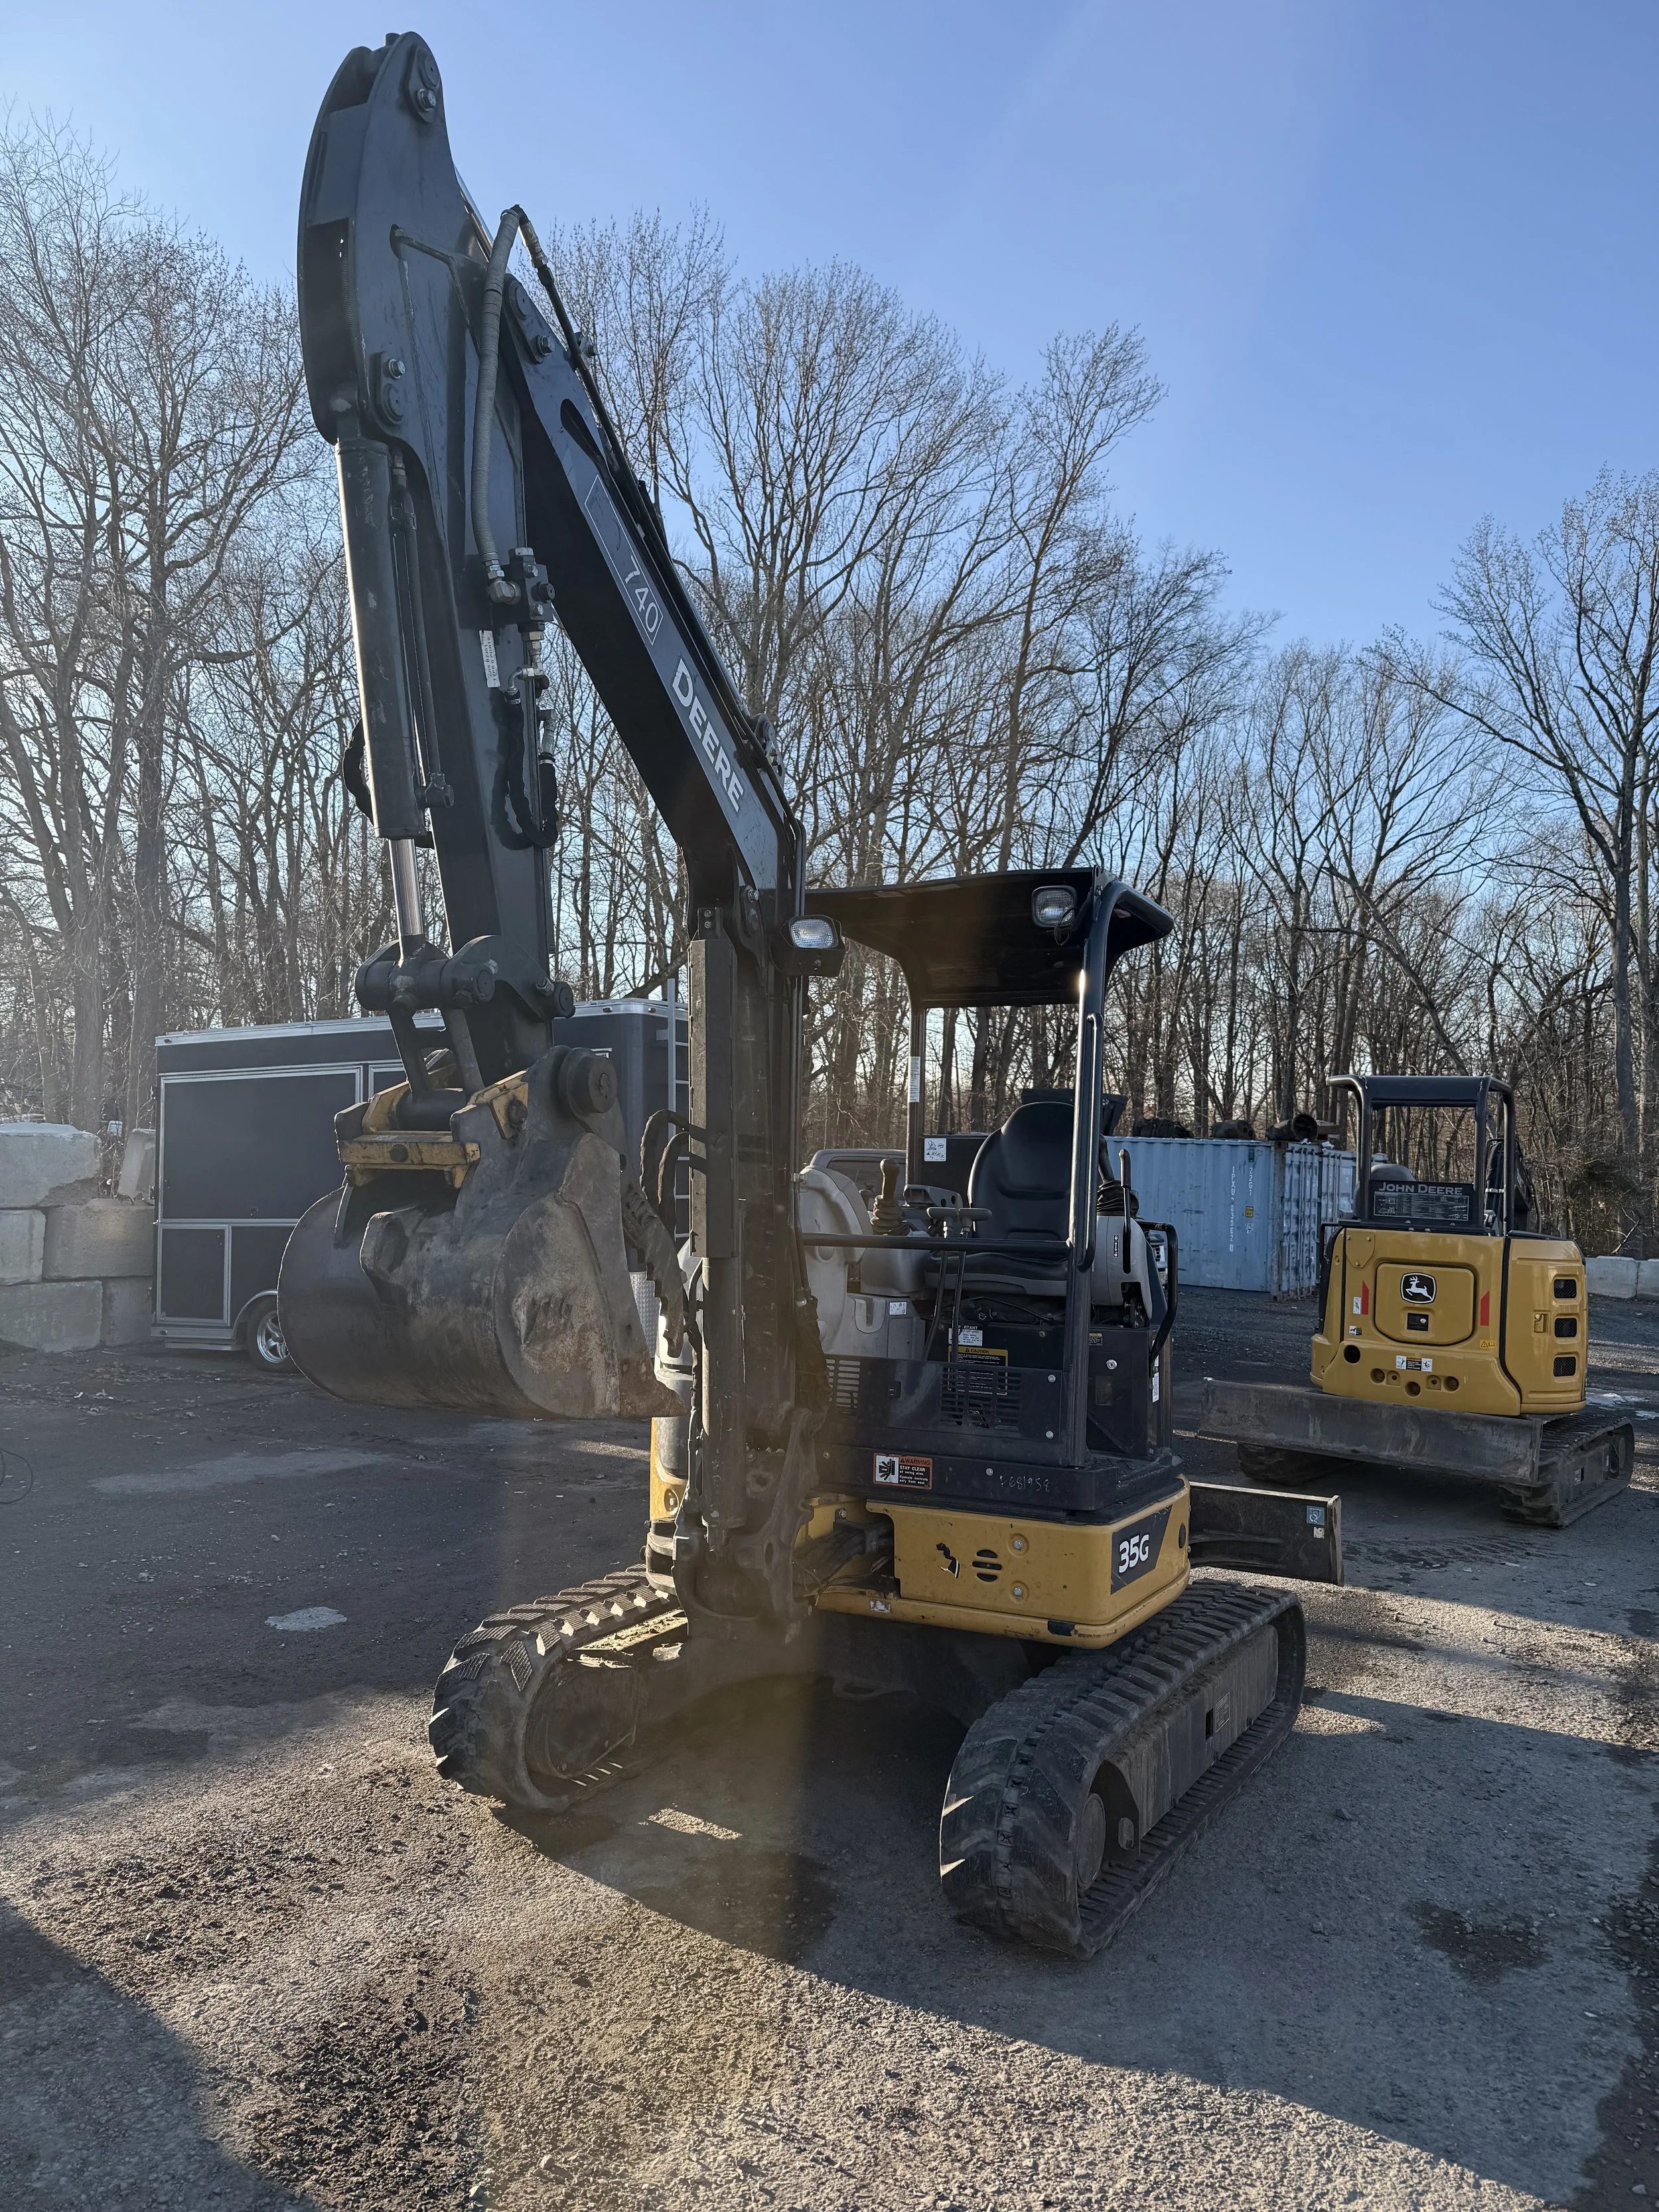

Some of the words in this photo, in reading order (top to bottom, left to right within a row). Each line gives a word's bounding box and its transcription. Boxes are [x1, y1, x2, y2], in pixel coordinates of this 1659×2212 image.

[625, 555, 658, 632] 740
[672, 658, 743, 812] DEERE
[1378, 1182, 1414, 1193] JOHN
[1418, 1184, 1463, 1195] DEERE
[1119, 1534, 1149, 1574] 35G
